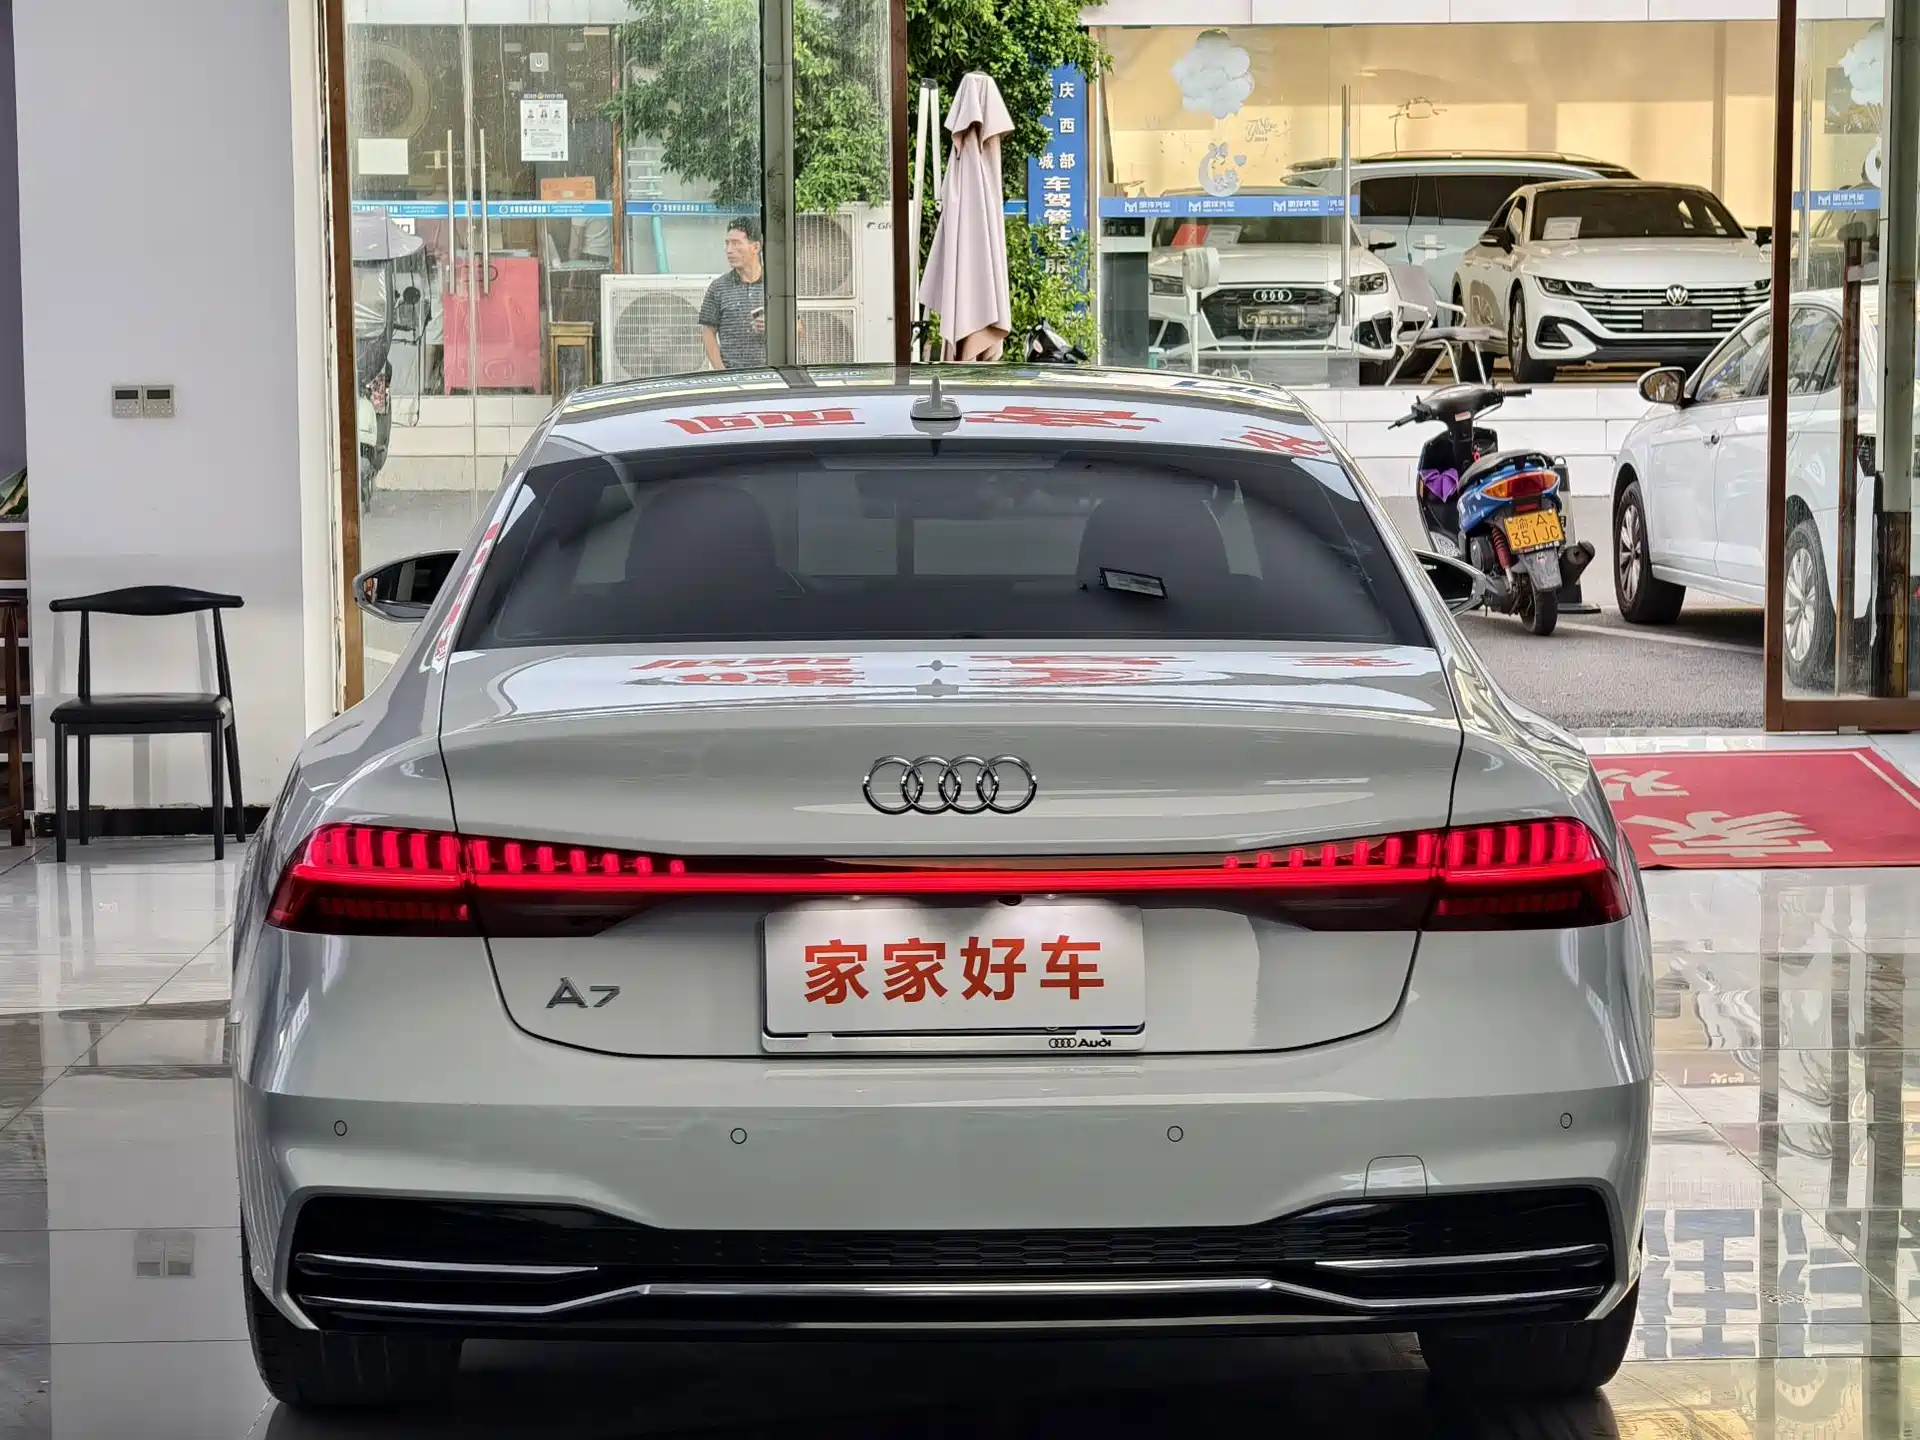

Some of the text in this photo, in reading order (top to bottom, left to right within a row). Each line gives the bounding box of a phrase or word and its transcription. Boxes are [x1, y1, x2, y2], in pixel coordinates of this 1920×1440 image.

[804, 935, 1104, 1005] 家家好车
[545, 976, 621, 1008] A7
[1078, 1038, 1111, 1048] Audi
